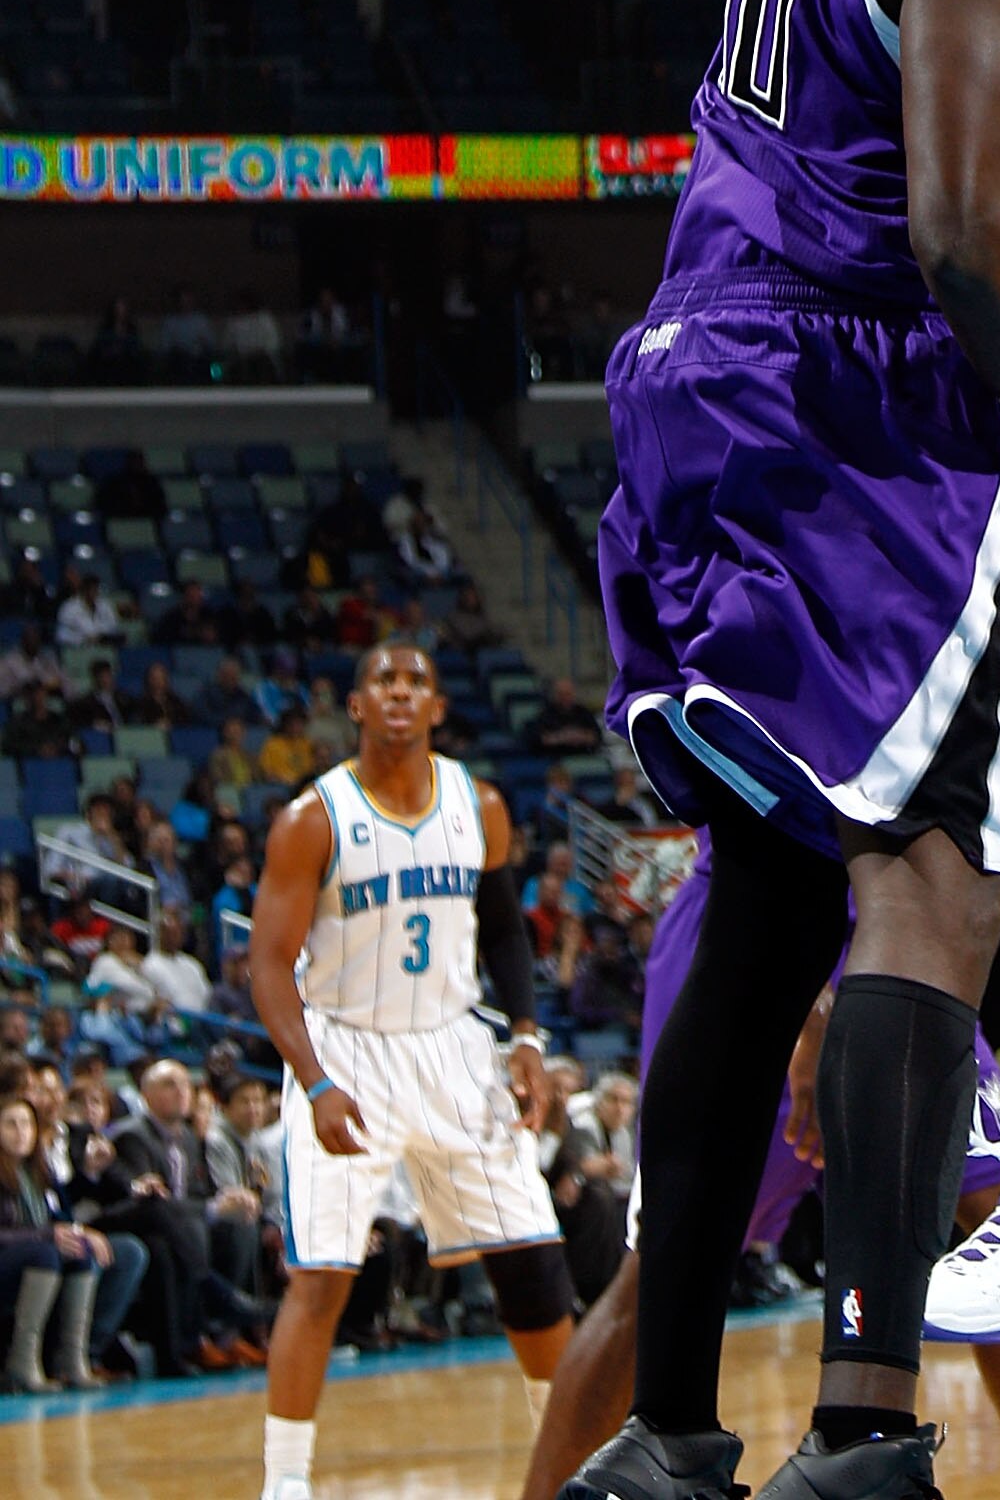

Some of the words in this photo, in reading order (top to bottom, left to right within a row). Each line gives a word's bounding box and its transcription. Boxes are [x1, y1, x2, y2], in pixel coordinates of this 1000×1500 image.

[59, 141, 389, 195] UNIFORM
[352, 822, 371, 845] C
[339, 873, 390, 917] NEW
[403, 913, 430, 973] 3
